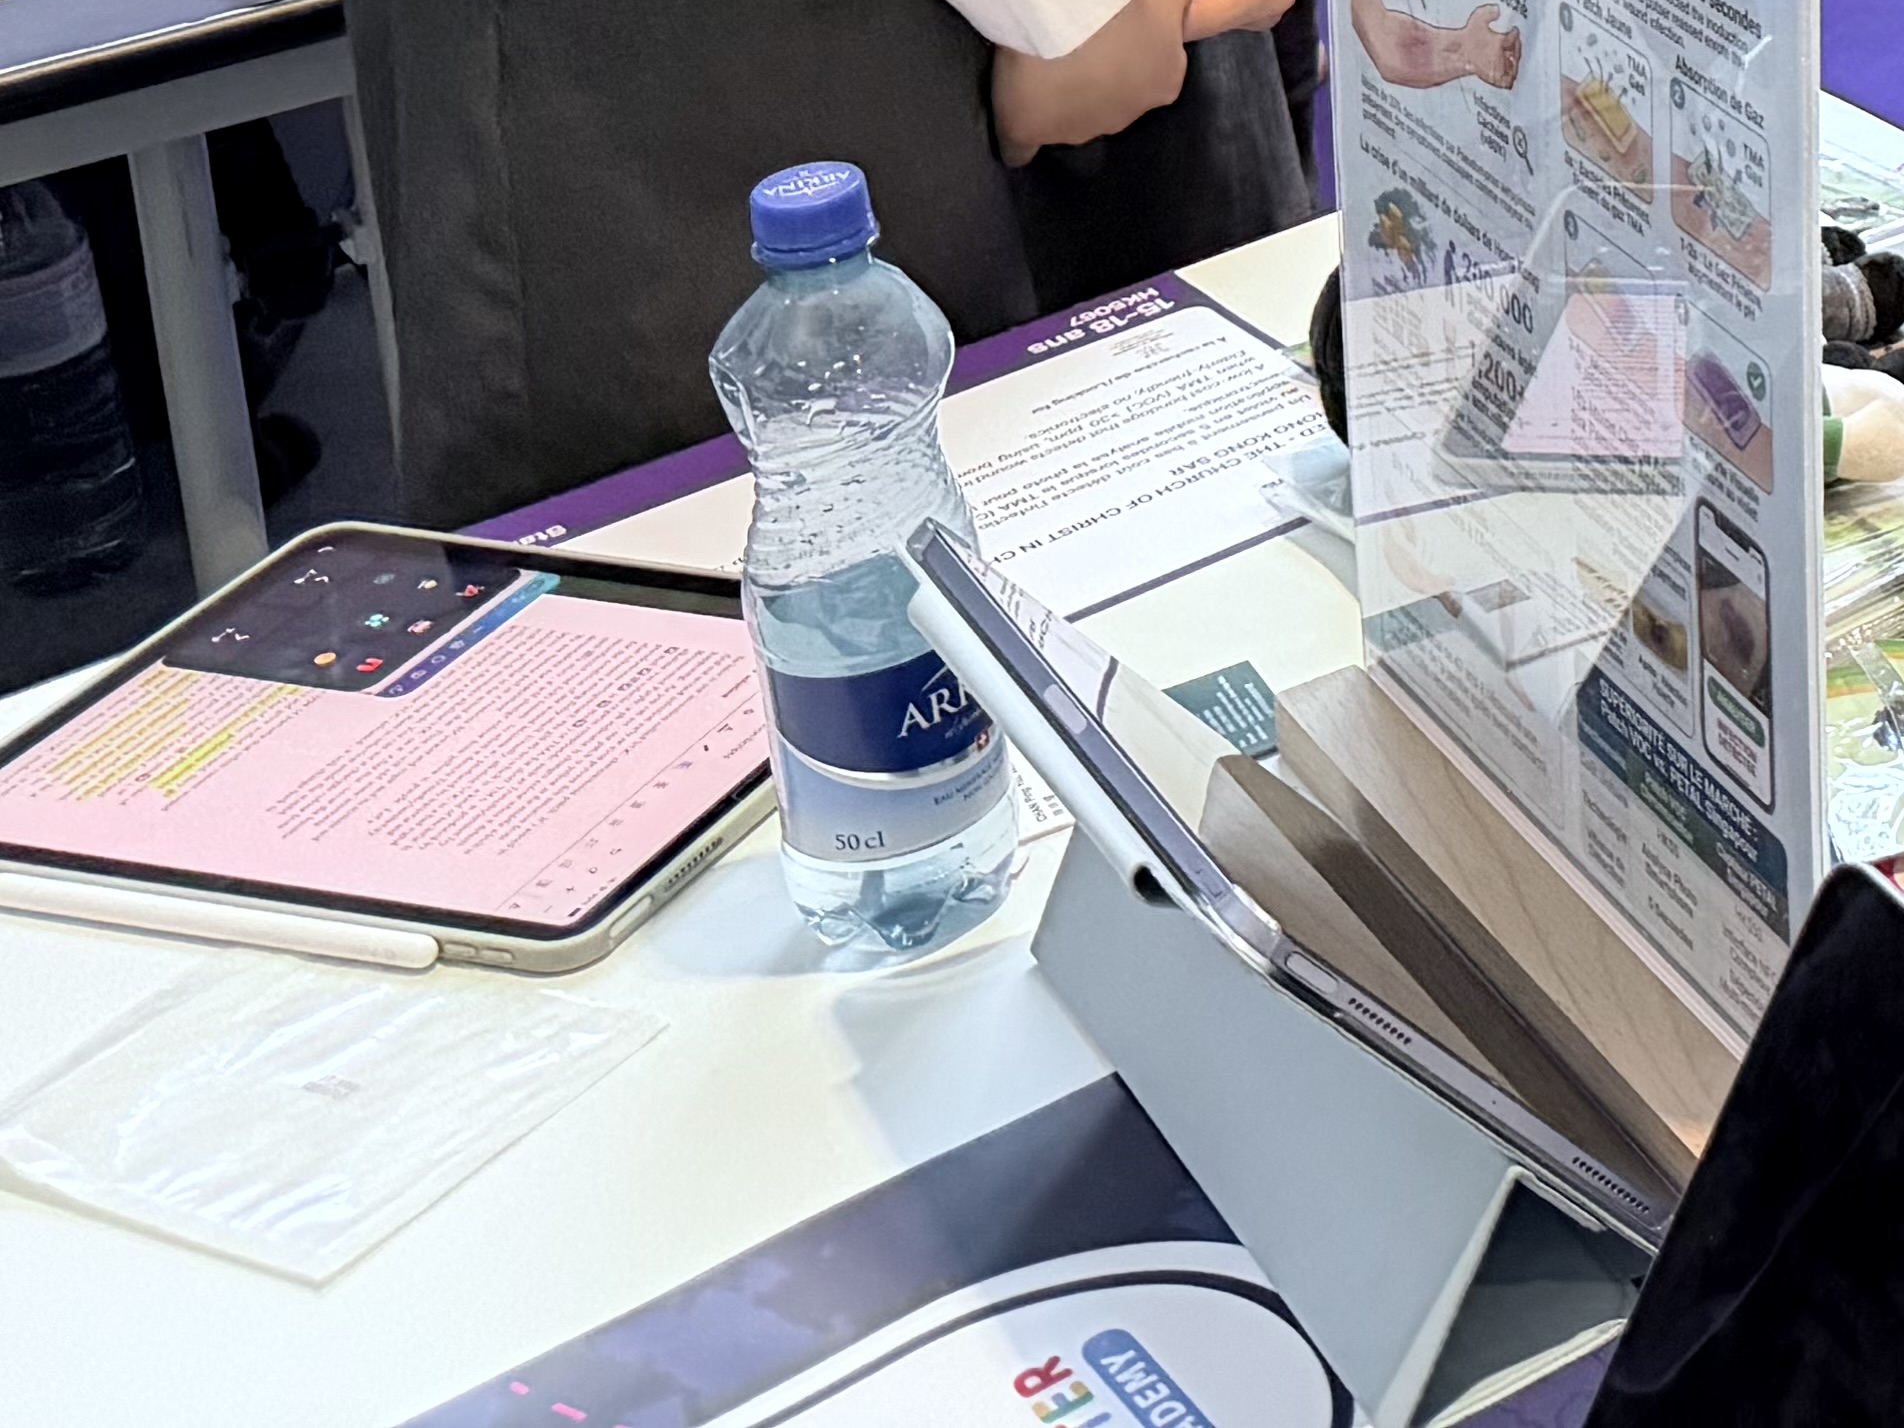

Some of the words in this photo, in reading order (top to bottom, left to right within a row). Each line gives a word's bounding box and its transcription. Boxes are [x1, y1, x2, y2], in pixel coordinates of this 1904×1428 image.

[1089, 297, 1174, 333] 15-18
[1027, 328, 1085, 353] ans
[1088, 422, 1120, 438] that
[997, 442, 1040, 462] using
[1213, 432, 1271, 457] KONG
[1244, 441, 1281, 460] THE
[974, 459, 1027, 483] wound
[1154, 458, 1241, 496] CHURCH
[1126, 493, 1153, 509] OF
[1048, 507, 1121, 542] CHRIST
[1018, 539, 1043, 552] IN
[1631, 726, 1652, 761] VOC
[834, 831, 863, 852] 50
[864, 830, 886, 851] cl
